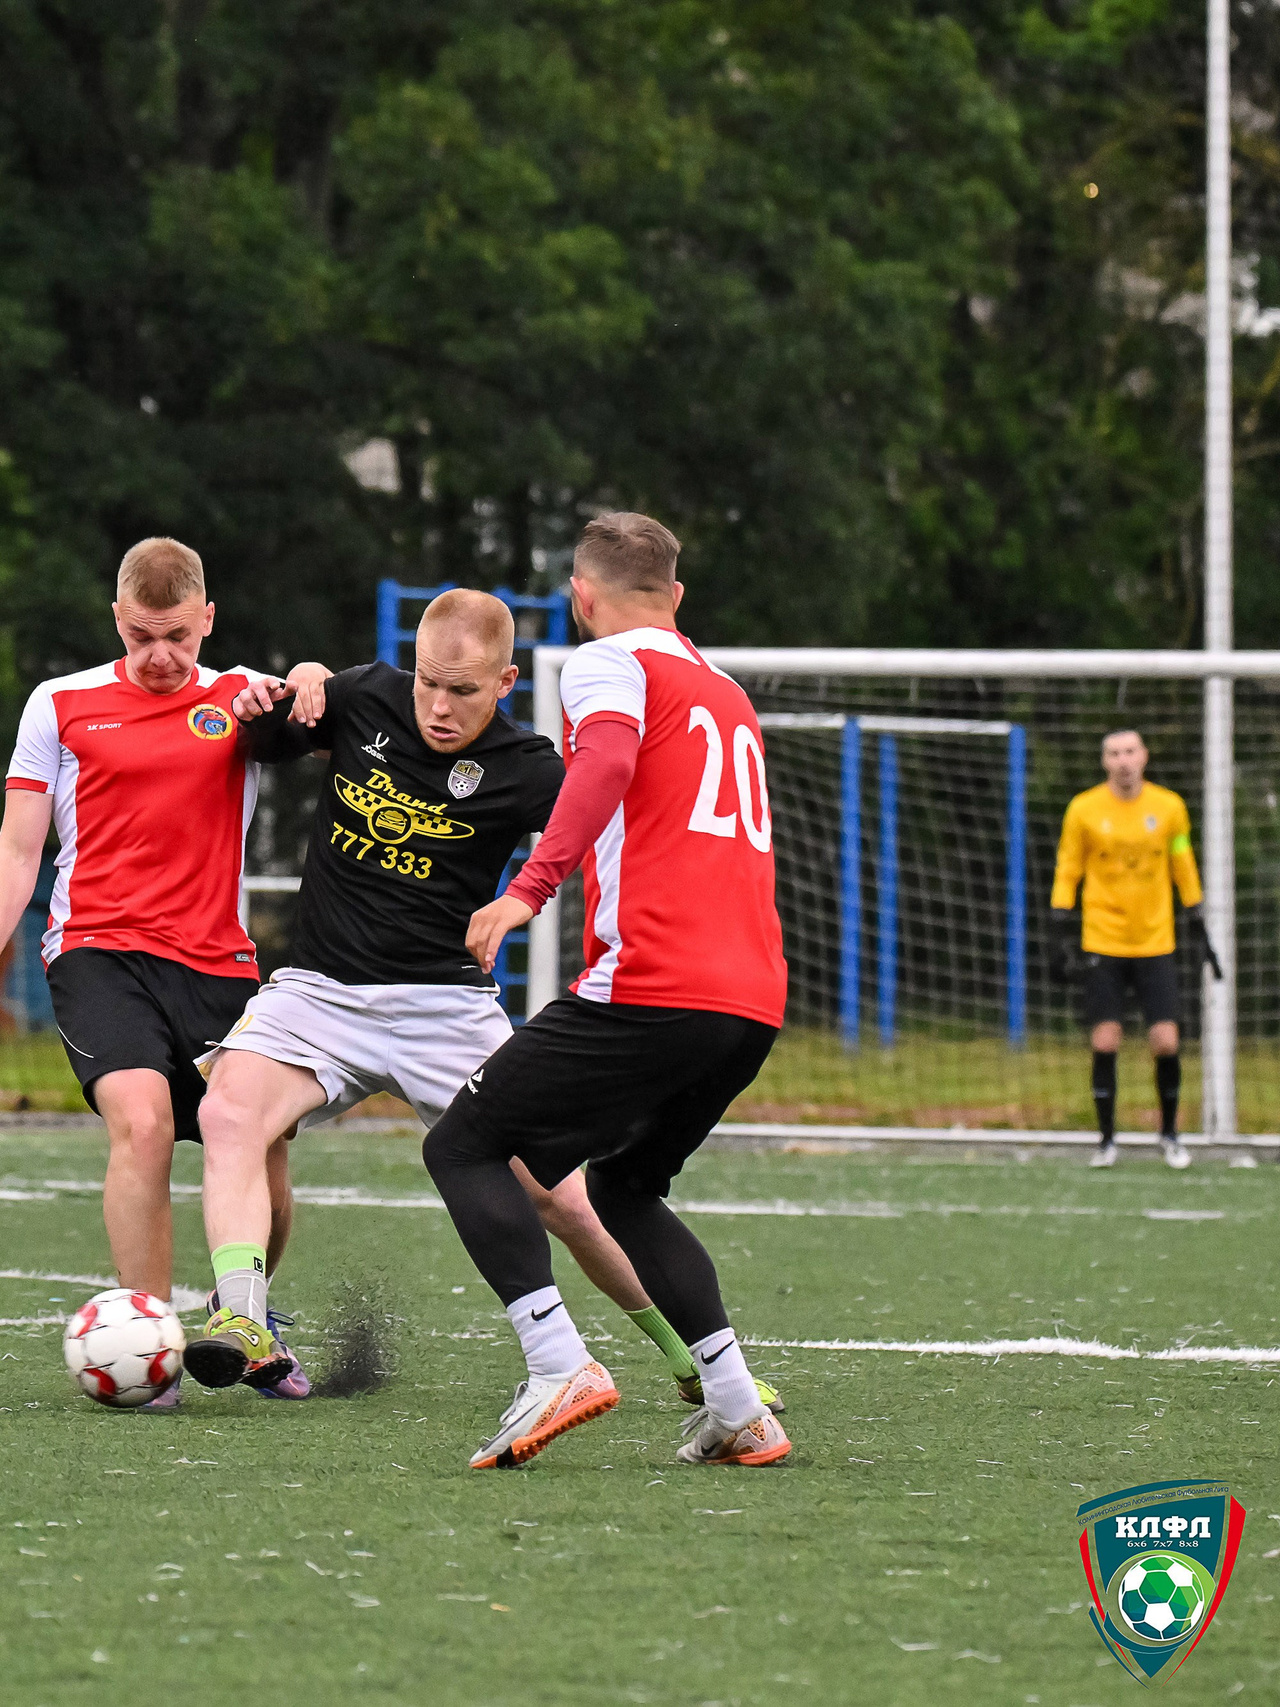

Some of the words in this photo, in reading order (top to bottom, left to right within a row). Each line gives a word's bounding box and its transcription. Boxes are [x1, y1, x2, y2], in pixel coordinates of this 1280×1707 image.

[365, 768, 449, 816] Brand
[687, 705, 772, 853] 20
[330, 821, 375, 861] 777
[380, 846, 432, 879] 333
